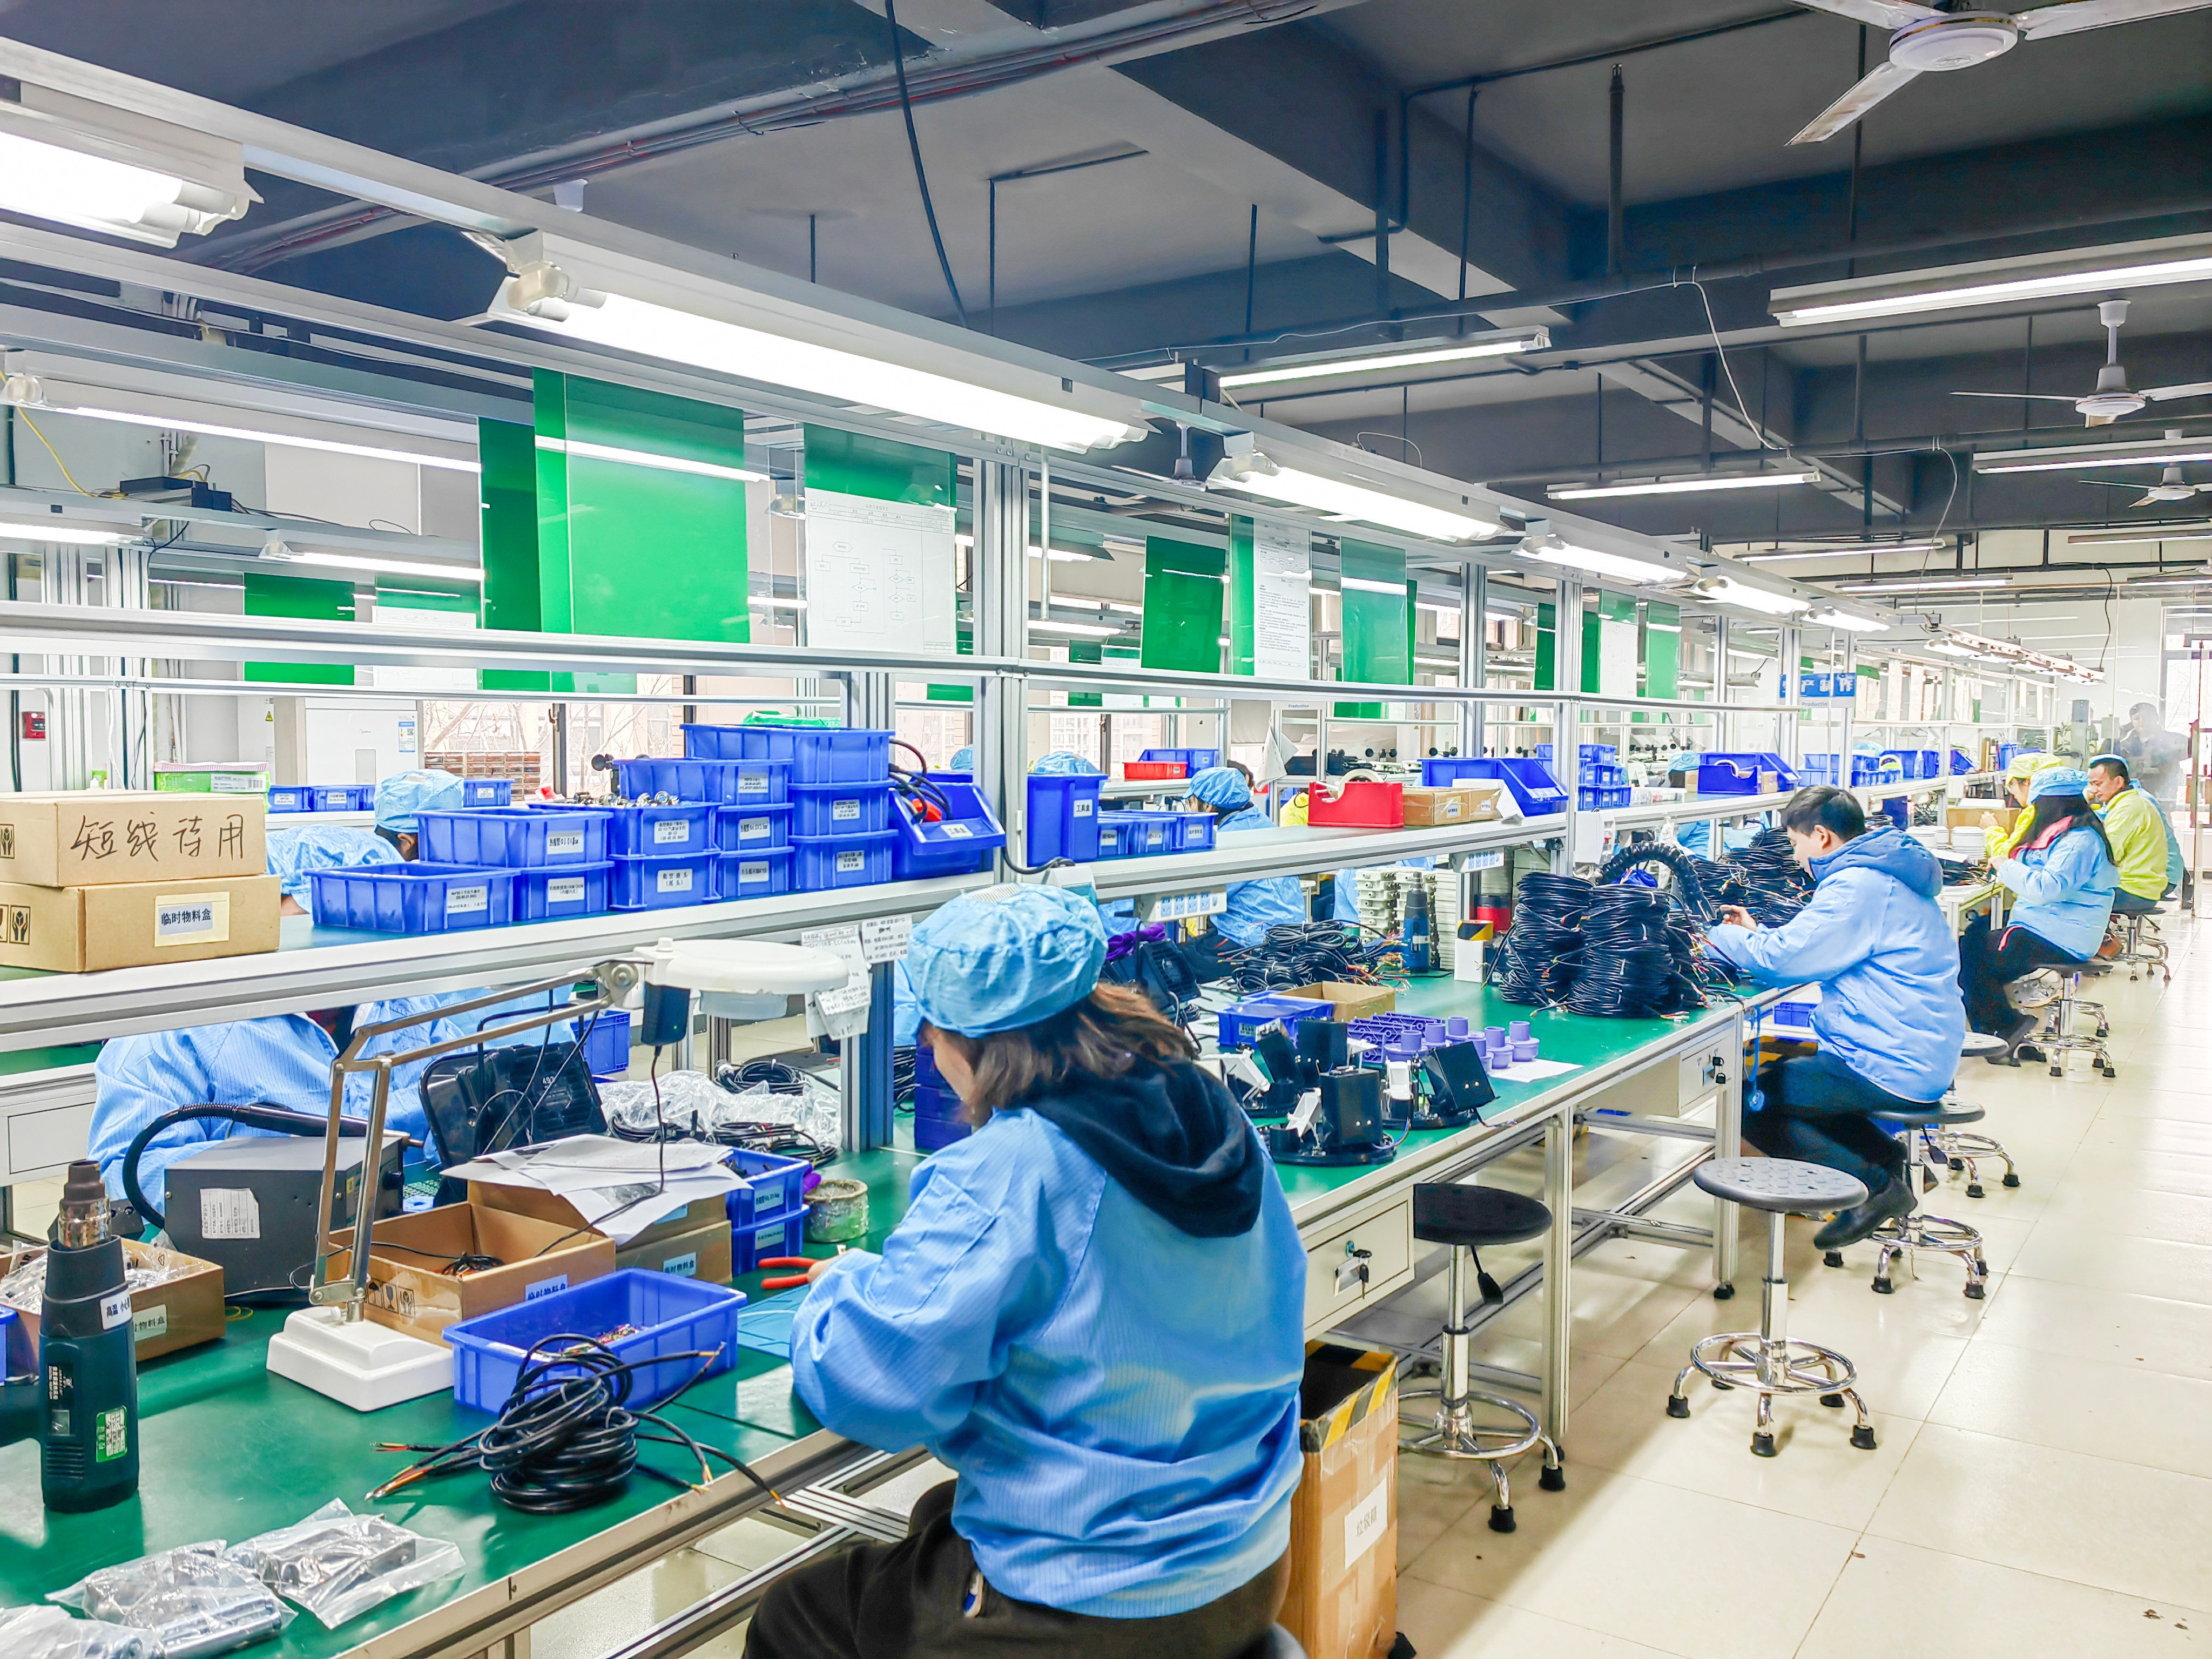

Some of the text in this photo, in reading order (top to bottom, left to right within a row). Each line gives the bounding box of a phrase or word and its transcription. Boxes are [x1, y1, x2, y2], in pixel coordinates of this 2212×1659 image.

[161, 908, 211, 926] 临时物料盒
[528, 1283, 565, 1301] 临时物料盒
